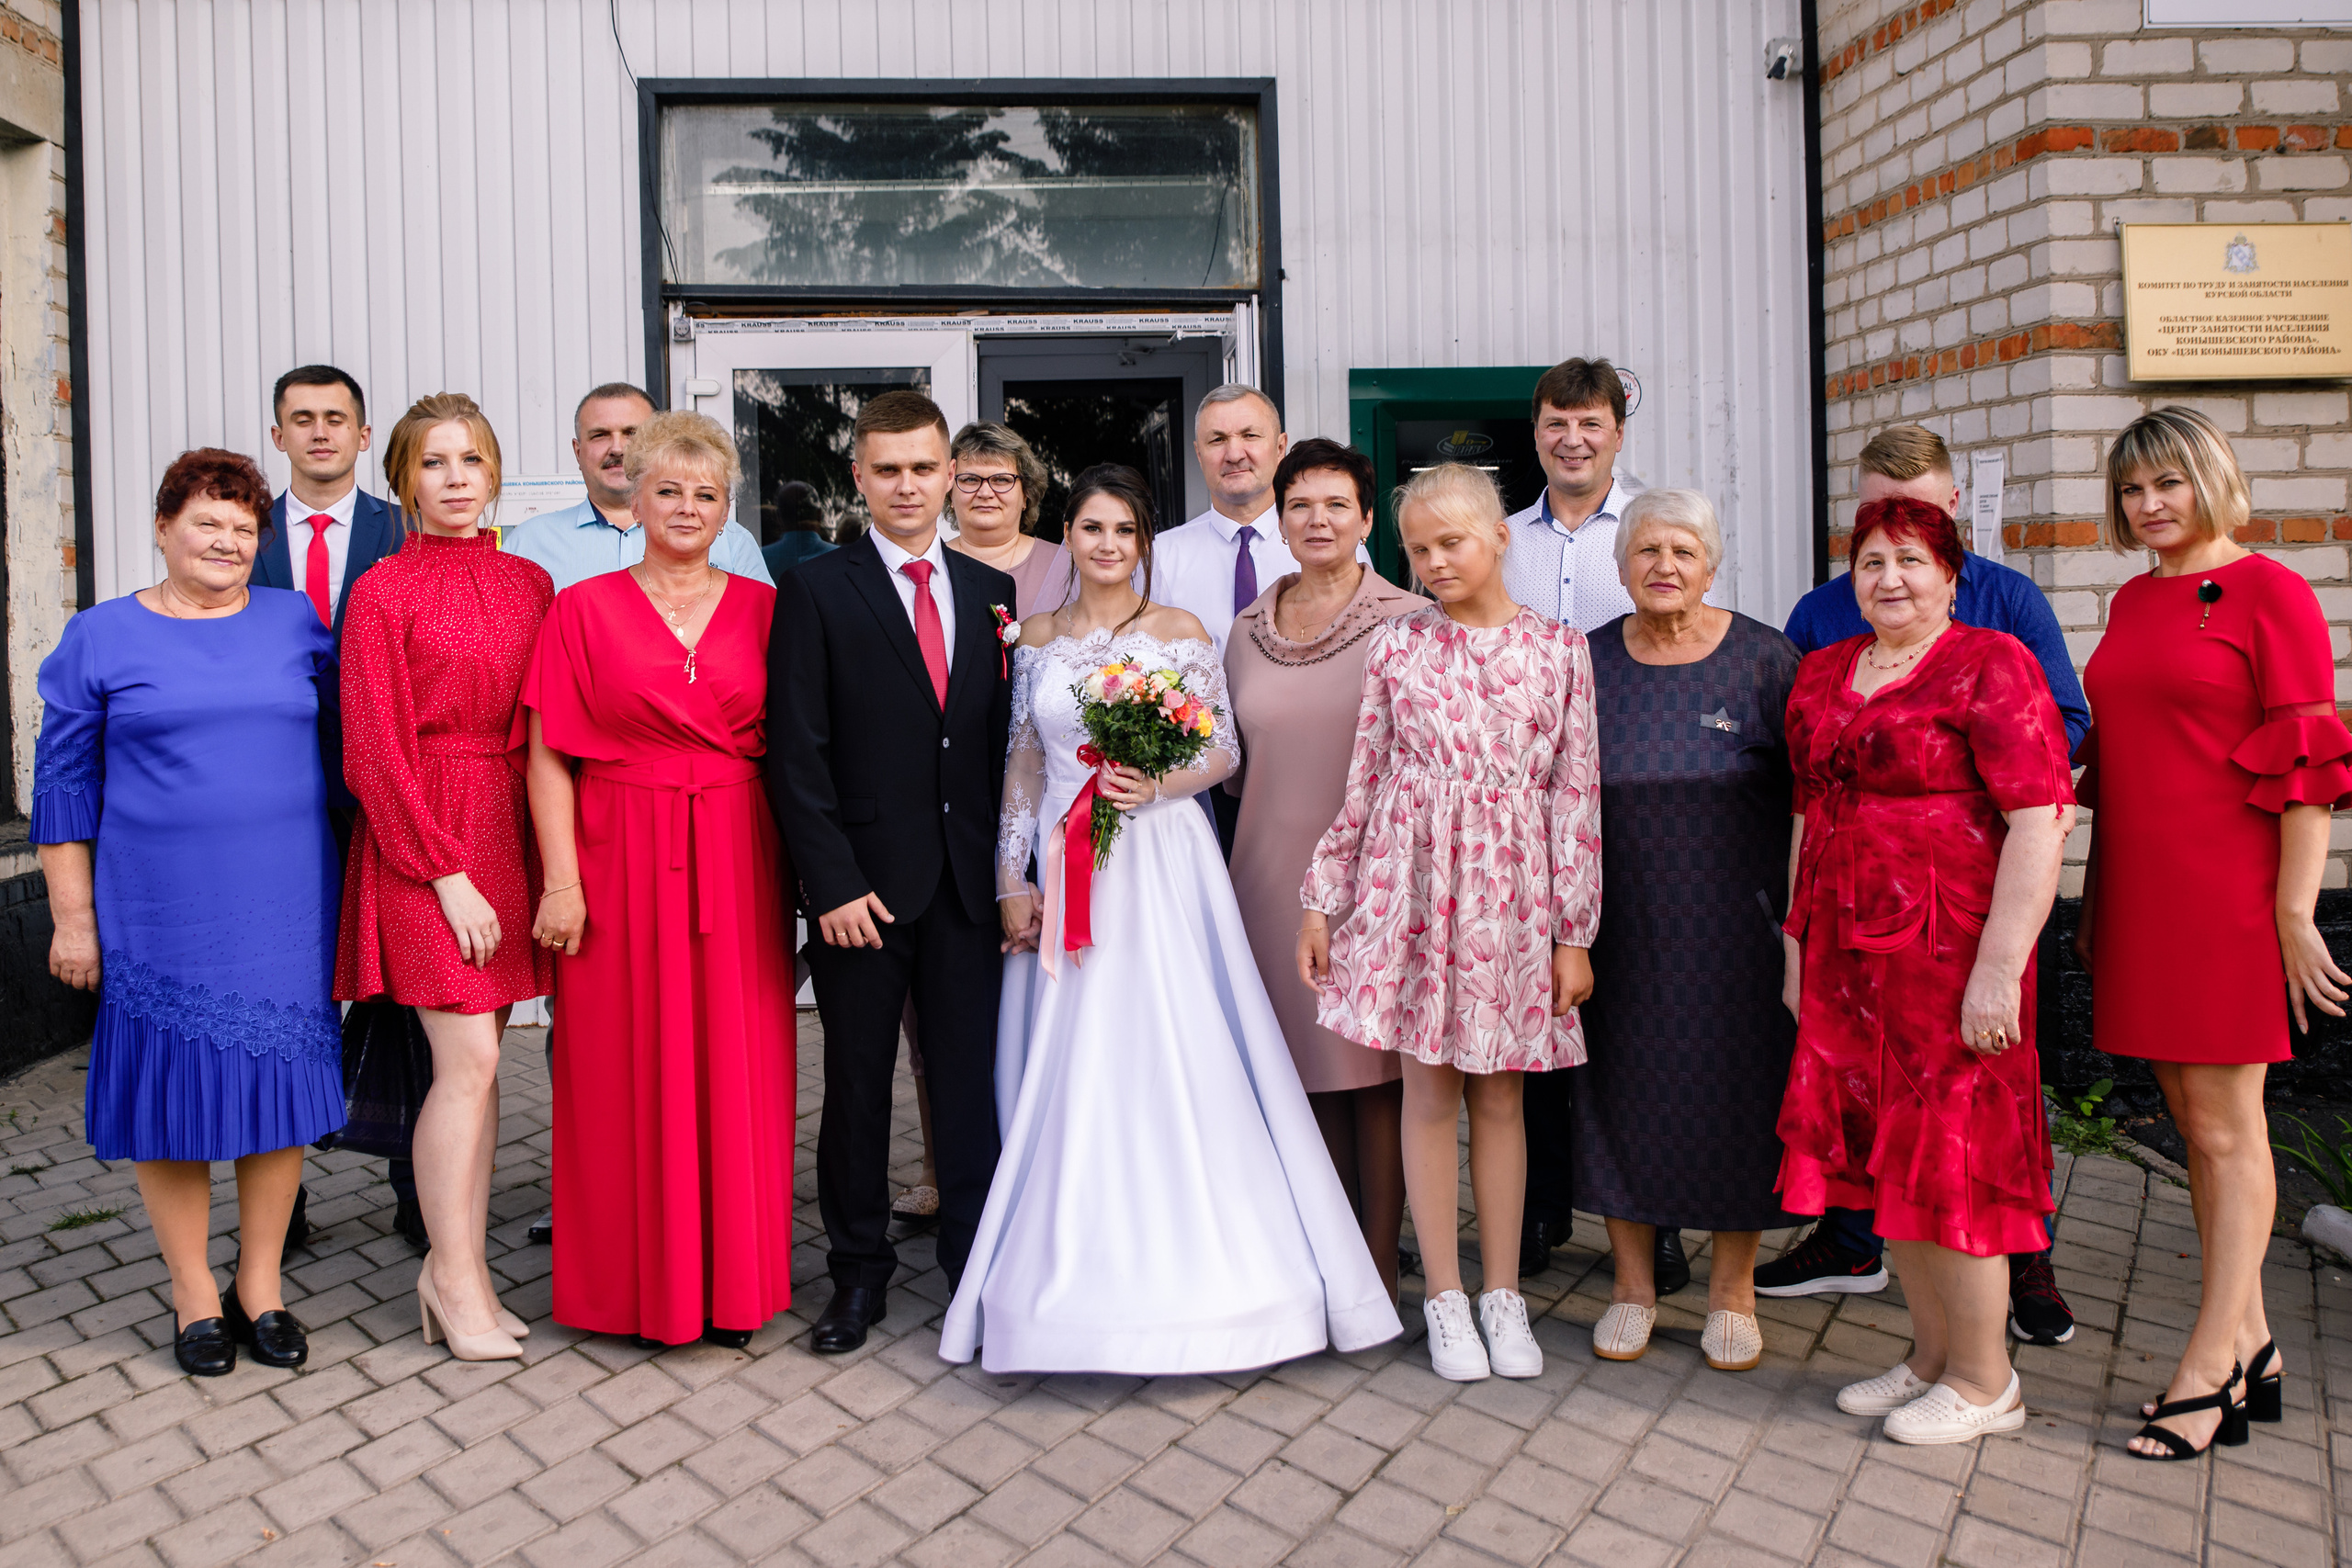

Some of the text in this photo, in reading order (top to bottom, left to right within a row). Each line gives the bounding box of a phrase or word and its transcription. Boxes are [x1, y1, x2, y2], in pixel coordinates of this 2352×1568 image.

[2137, 281, 2181, 289] КОМИТЕТ
[2183, 281, 2196, 289] ПО
[2198, 281, 2227, 289] ТРУДУ
[2237, 280, 2291, 288] ЗАНЯТОСТИ
[2293, 279, 2349, 288] НАСЕЛЕНИЯ
[2205, 289, 2248, 298] КУРСКОЙ
[2215, 314, 2264, 322] КАЗЕННОЕ
[2266, 313, 2330, 321] УЧРЕЖДЕНИЕ
[2158, 323, 2330, 334] «ЦЕНТР ЗАНЯТОСТИ НАСЕЛЕНИЯ
[2176, 335, 2267, 344] КОНЫШЕВСКОГО
[2147, 344, 2342, 356] ОКУ «ЦЗН КОНЫШЕВСКОГО РАЙОНА»
